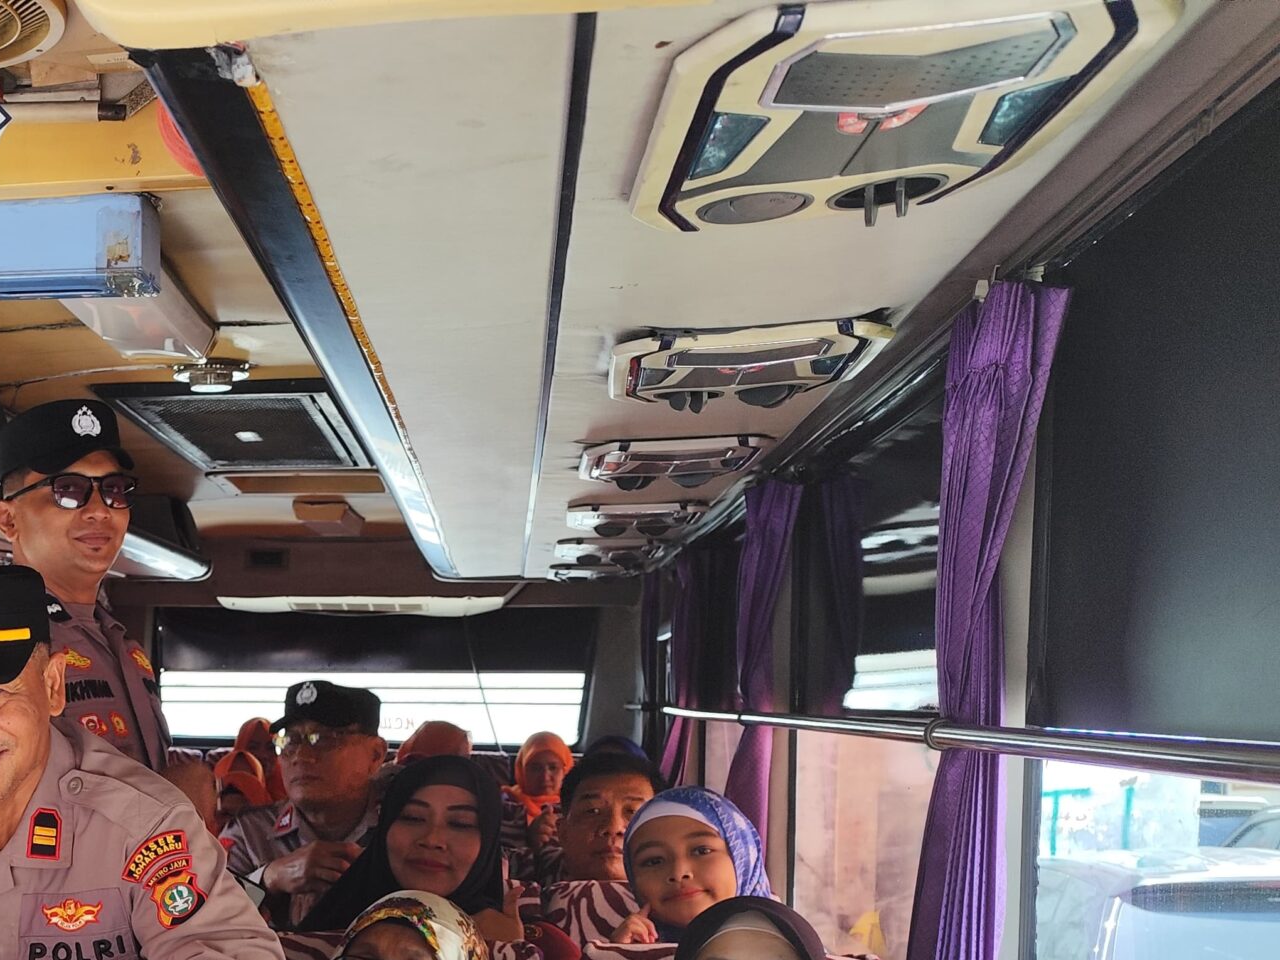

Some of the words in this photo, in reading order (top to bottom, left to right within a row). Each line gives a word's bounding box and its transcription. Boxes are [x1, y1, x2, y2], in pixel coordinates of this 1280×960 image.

[129, 834, 176, 872] POLSEK
[132, 852, 157, 880] JOHAR
[156, 841, 182, 856] BARU
[148, 866, 169, 887] METRO
[169, 859, 187, 870] JAYA
